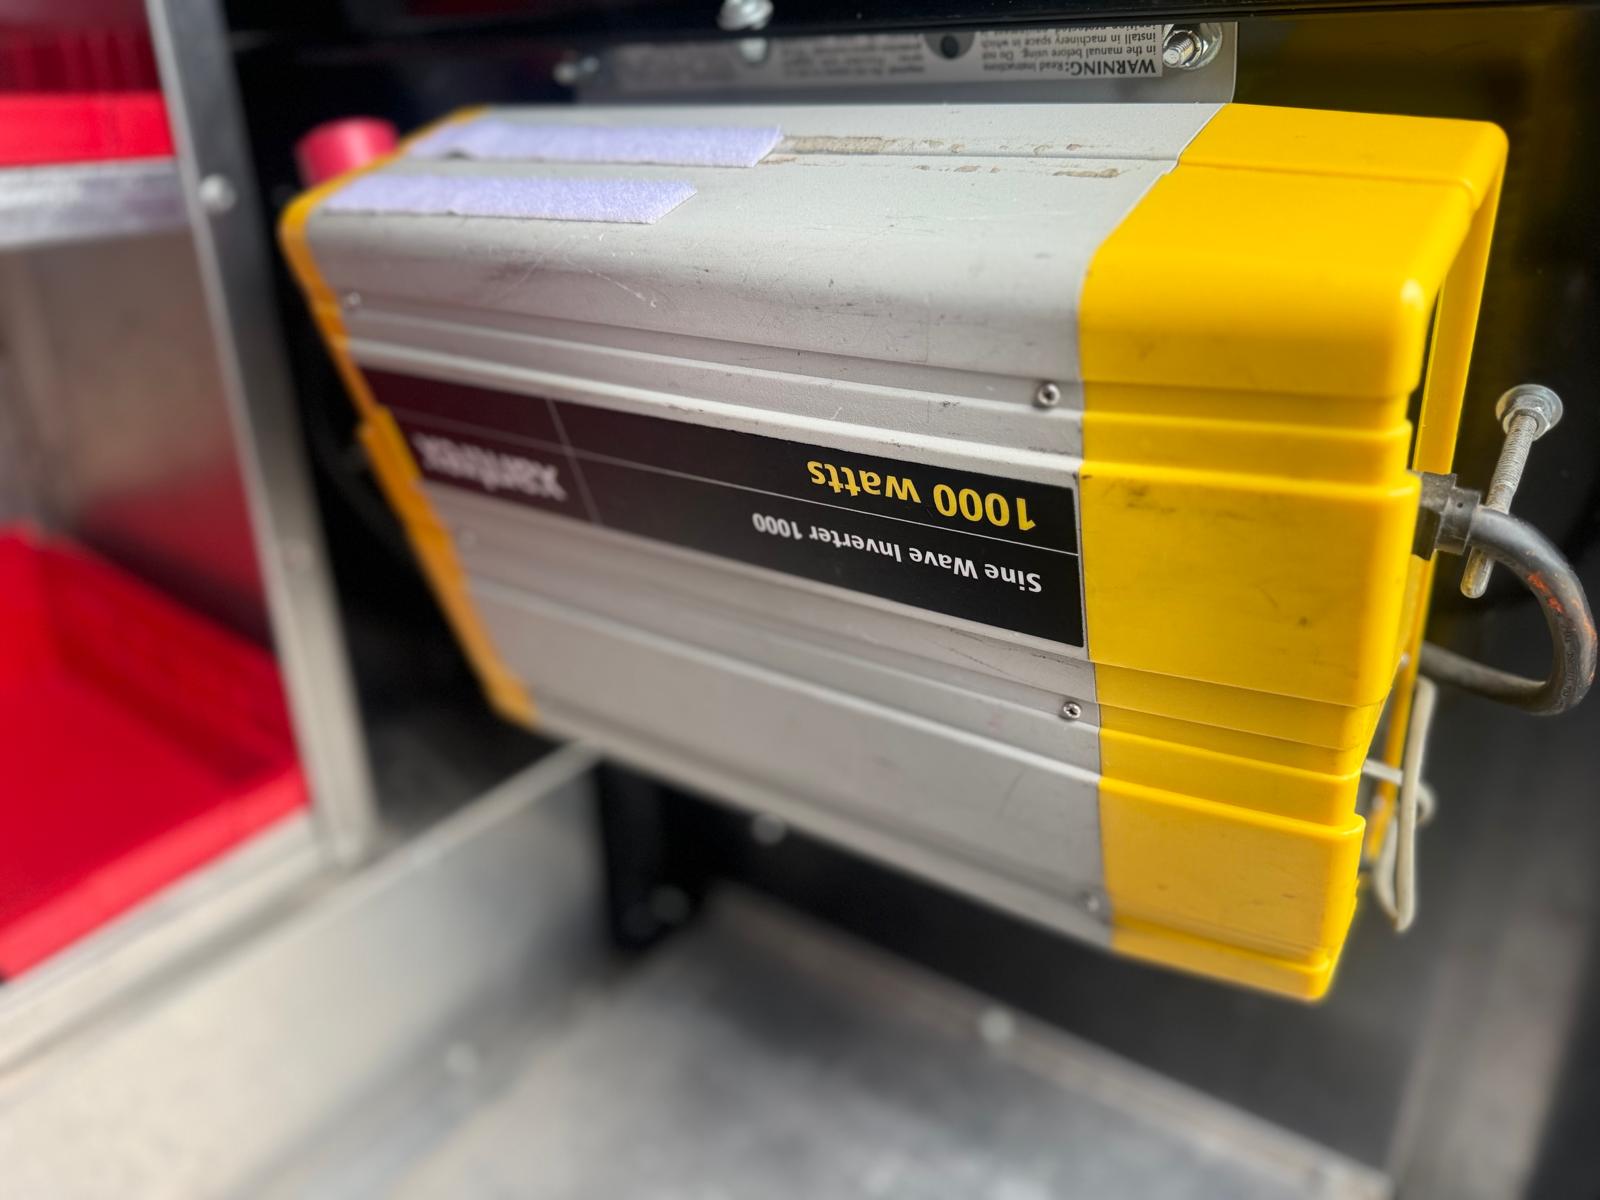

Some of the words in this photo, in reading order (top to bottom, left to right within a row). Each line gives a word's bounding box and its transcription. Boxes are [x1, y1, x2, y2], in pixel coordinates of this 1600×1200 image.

[1025, 36, 1052, 46] space
[1055, 35, 1107, 46] machinery
[1110, 34, 1121, 45] in
[1125, 33, 1156, 45] install
[1052, 48, 1082, 59] before
[1086, 47, 1123, 58] manual
[1126, 46, 1142, 57] the
[1146, 45, 1157, 56] in
[1040, 62, 1064, 72] Read
[1065, 59, 1157, 76] WARNING:
[807, 460, 922, 503] watts
[933, 483, 1036, 531] 1000
[752, 512, 803, 540] 1000
[809, 525, 902, 562] Inverter
[909, 547, 978, 580] Wave
[985, 563, 1042, 593] Sine
